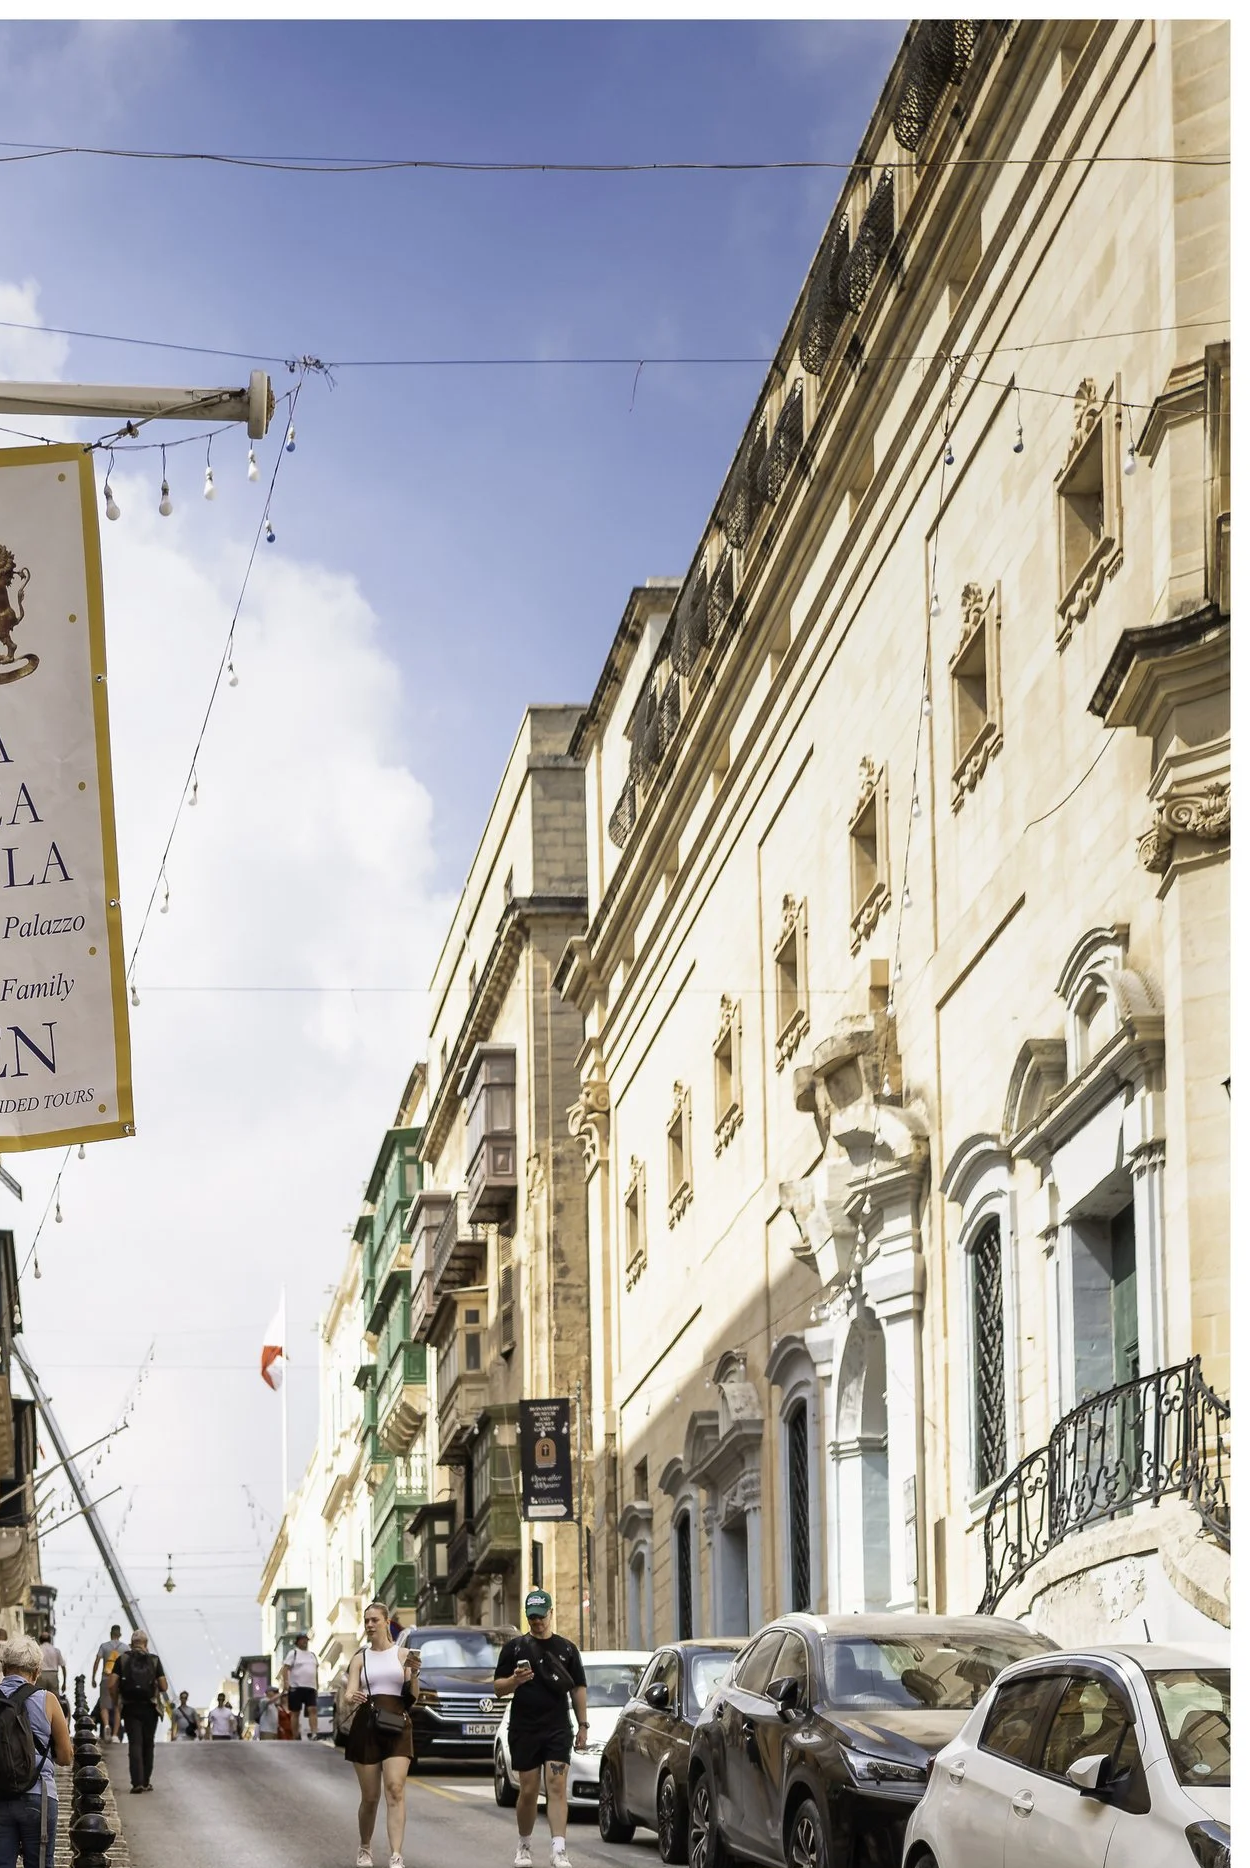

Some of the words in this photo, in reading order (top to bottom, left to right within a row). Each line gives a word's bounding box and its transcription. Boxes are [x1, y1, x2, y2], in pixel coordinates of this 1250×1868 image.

[2, 913, 86, 940] Palazzo
[0, 972, 75, 1002] Family
[43, 1087, 95, 1110] TOURS
[468, 1725, 486, 1734] HCA
